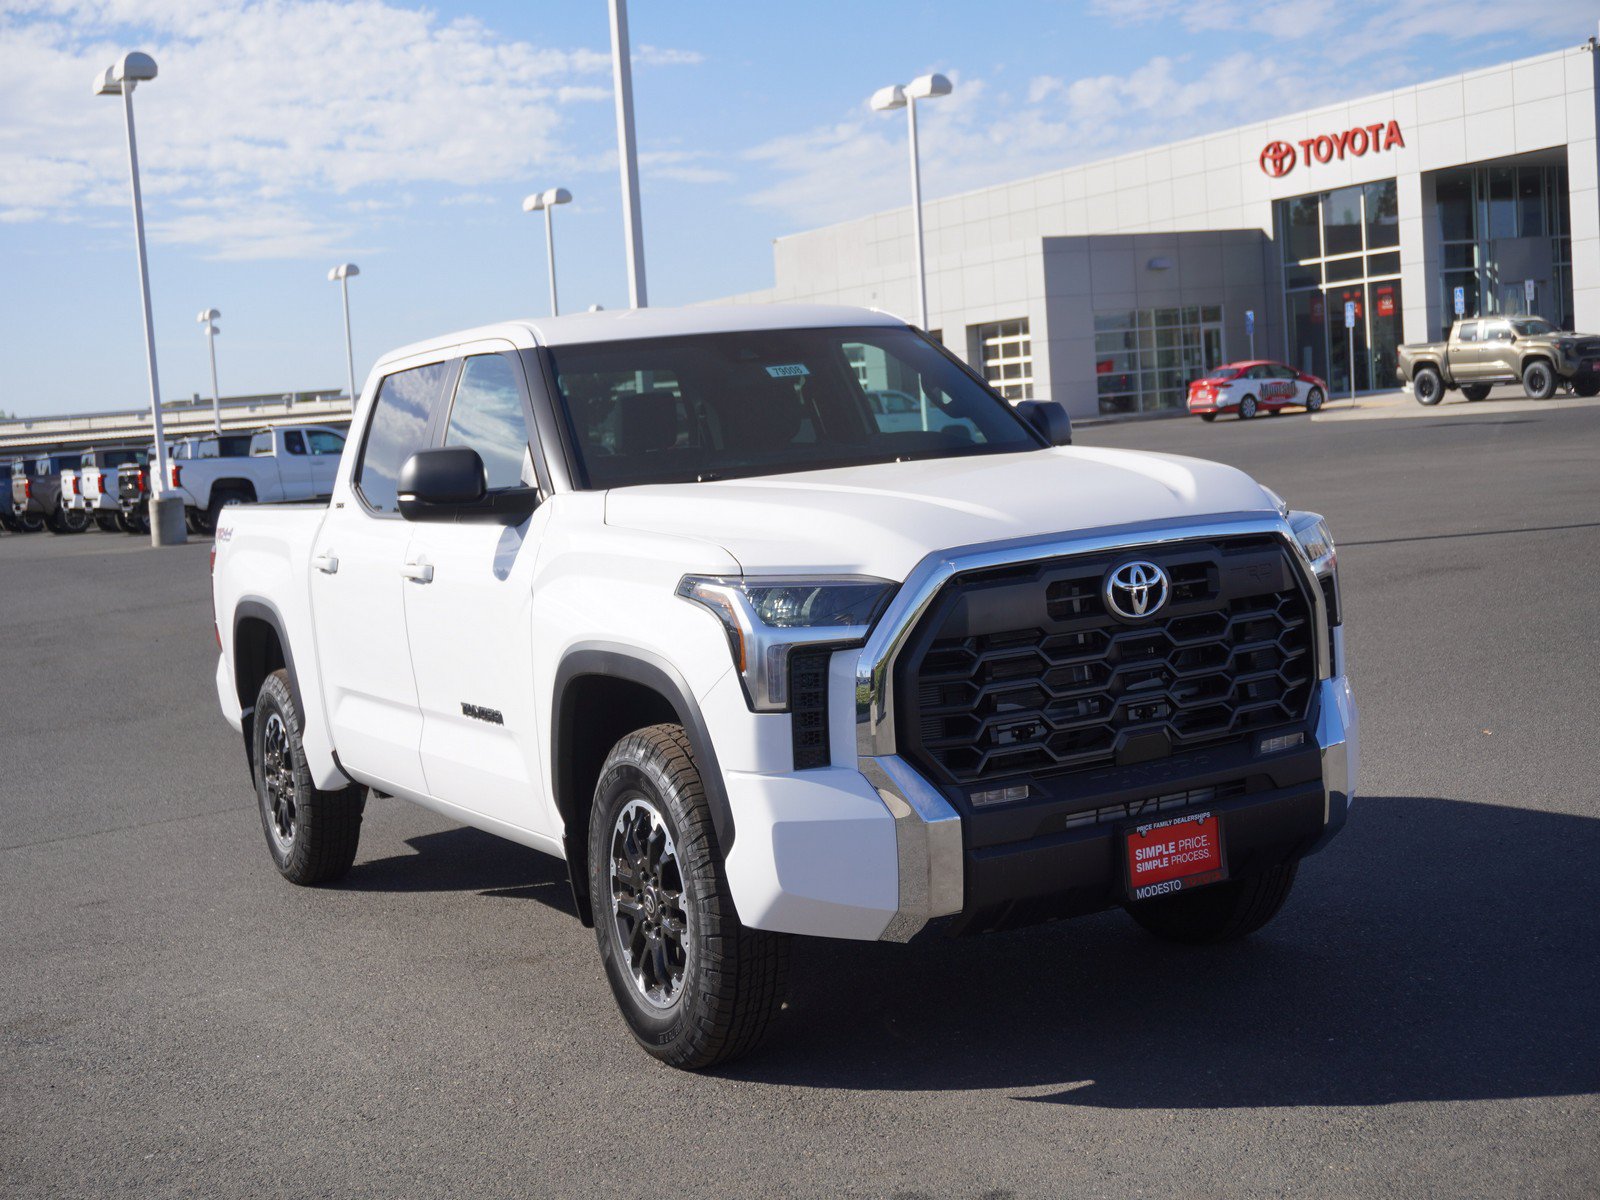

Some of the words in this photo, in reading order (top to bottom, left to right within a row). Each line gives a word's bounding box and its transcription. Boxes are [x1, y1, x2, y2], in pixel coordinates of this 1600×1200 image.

[1298, 119, 1405, 167] TOYOTA
[1136, 823, 1152, 833] PRICE
[1153, 820, 1173, 829] FAMILY
[1173, 811, 1211, 825] DEALERSHIPS
[1135, 842, 1176, 860] SIMPLE
[1178, 835, 1211, 851] PRICE.
[1136, 858, 1169, 873] SIMPLE
[1171, 849, 1211, 866] PROCESS.
[1136, 880, 1182, 900] MODESTO
